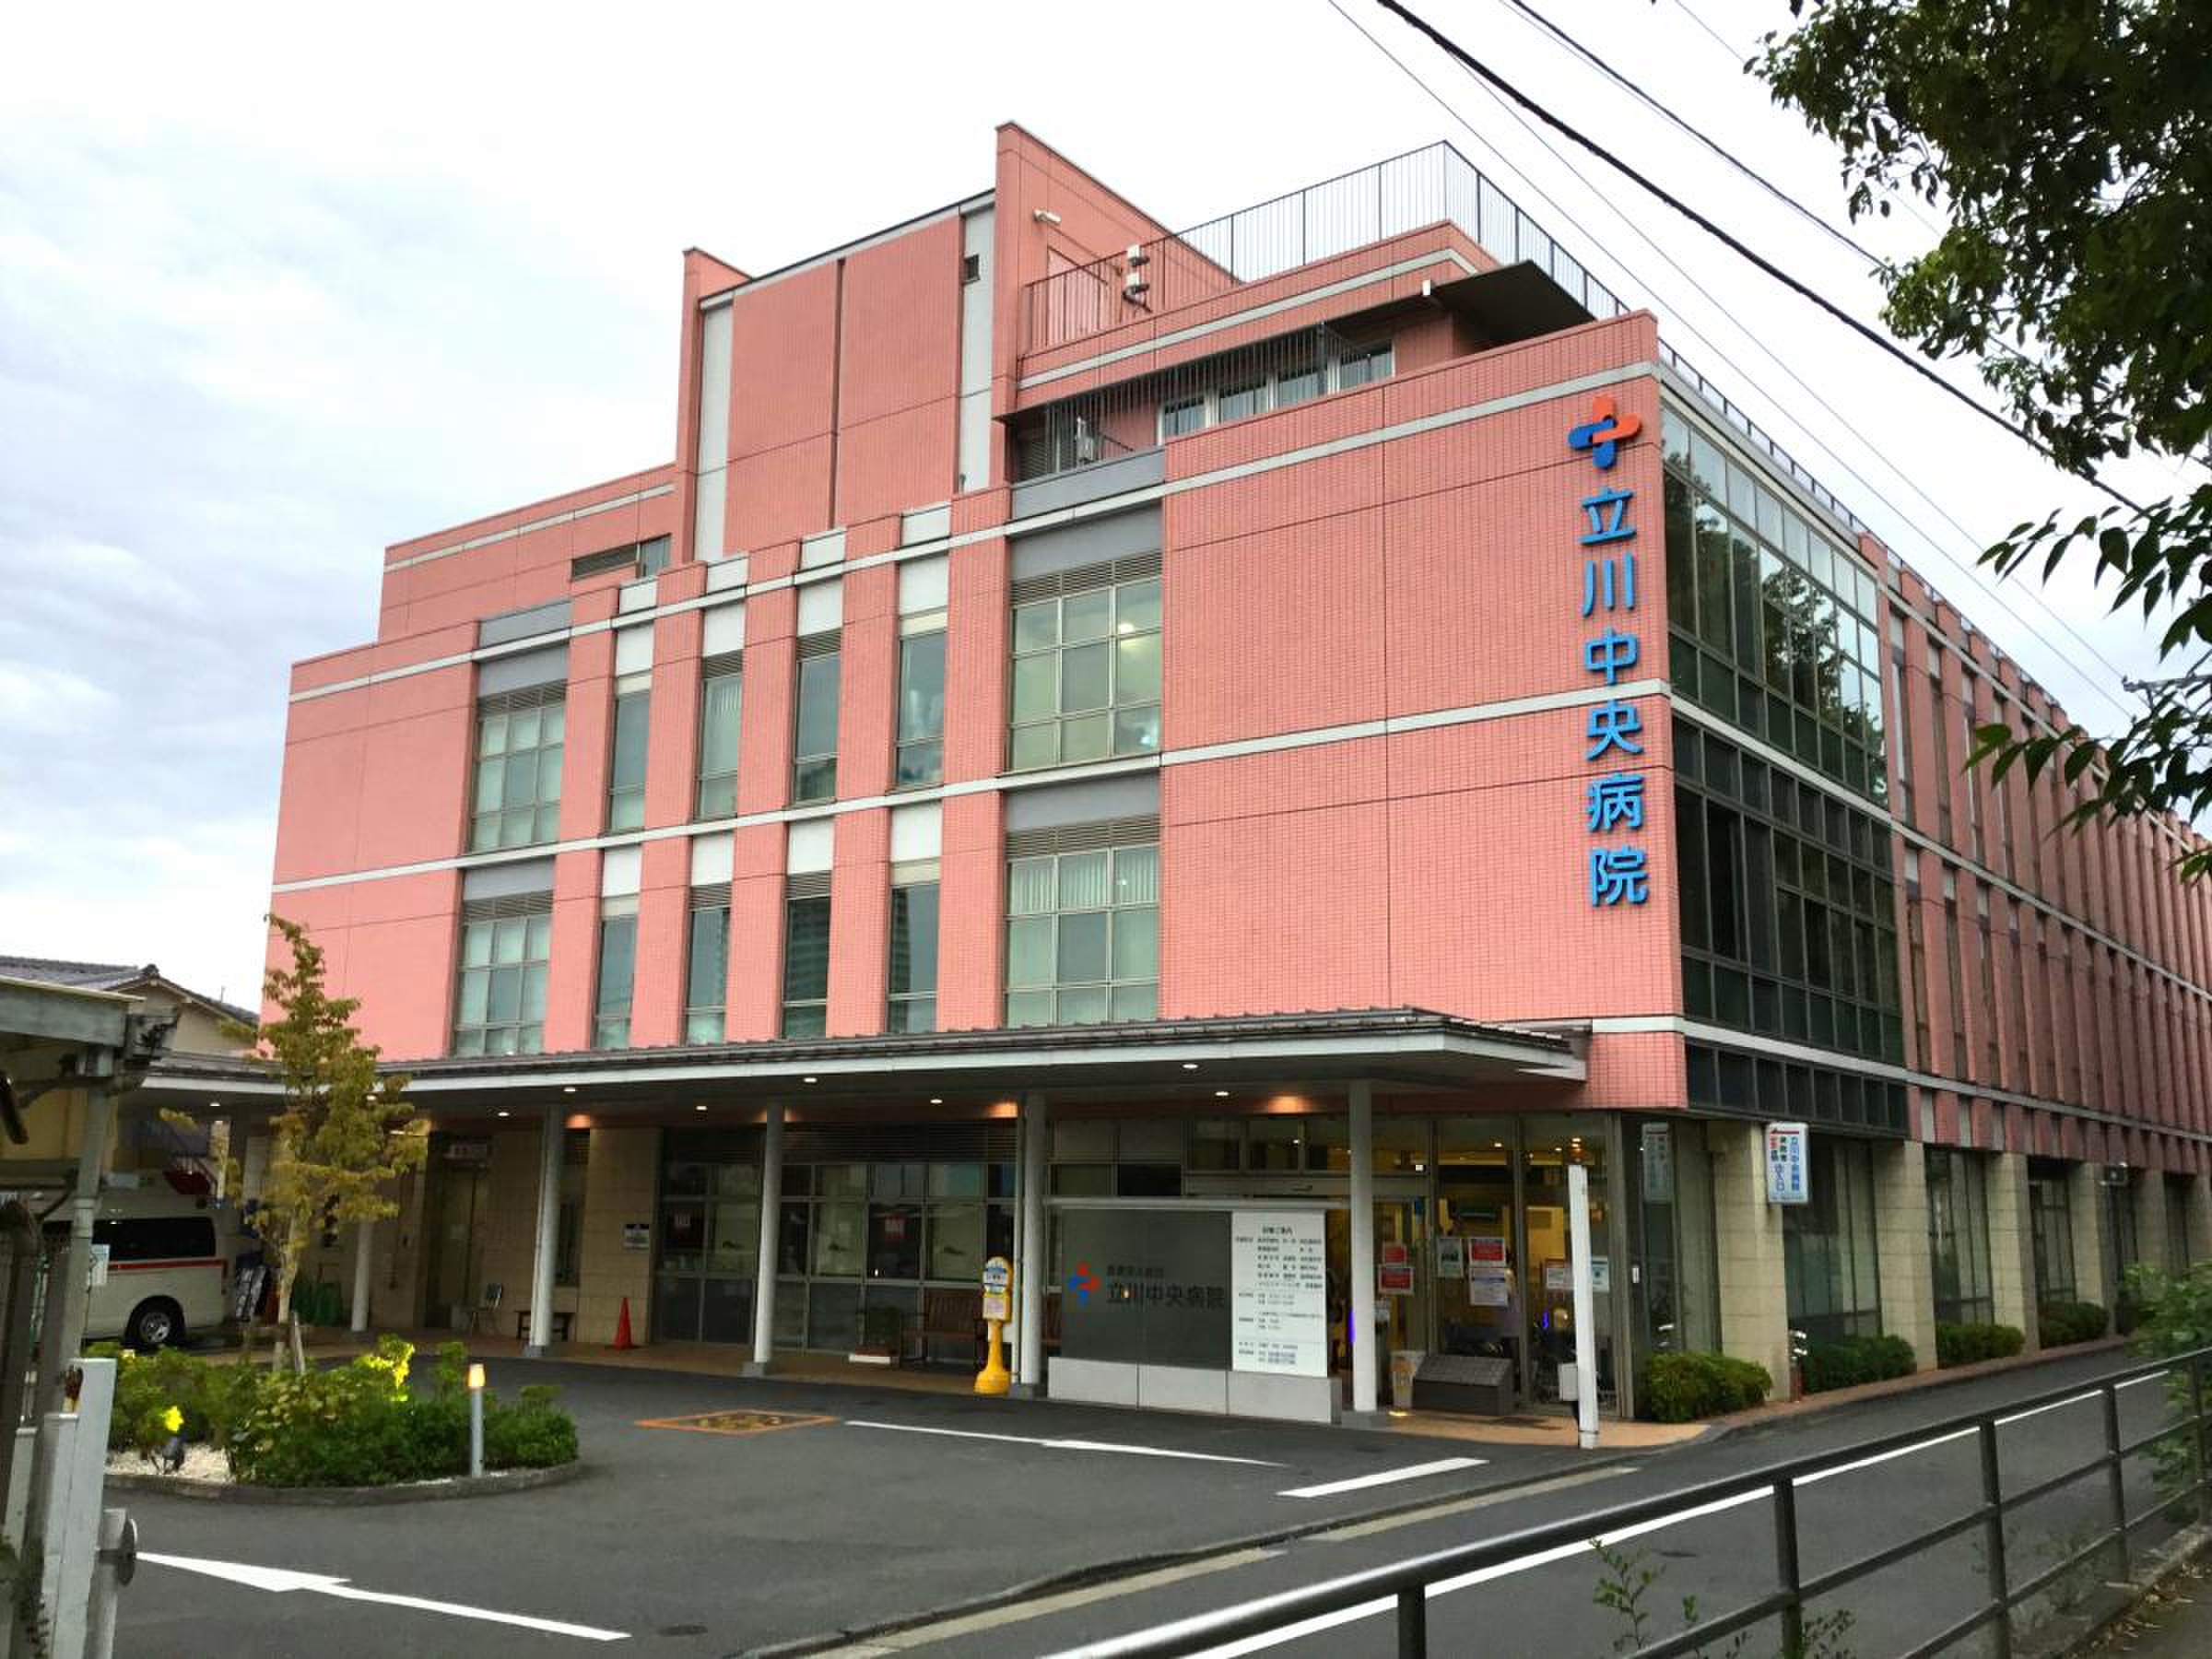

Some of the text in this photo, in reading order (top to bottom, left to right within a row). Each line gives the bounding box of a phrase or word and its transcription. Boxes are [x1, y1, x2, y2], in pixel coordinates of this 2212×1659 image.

[1578, 486, 1649, 908] 立川中央病院
[1107, 1282, 1225, 1310] 立川中央病院
